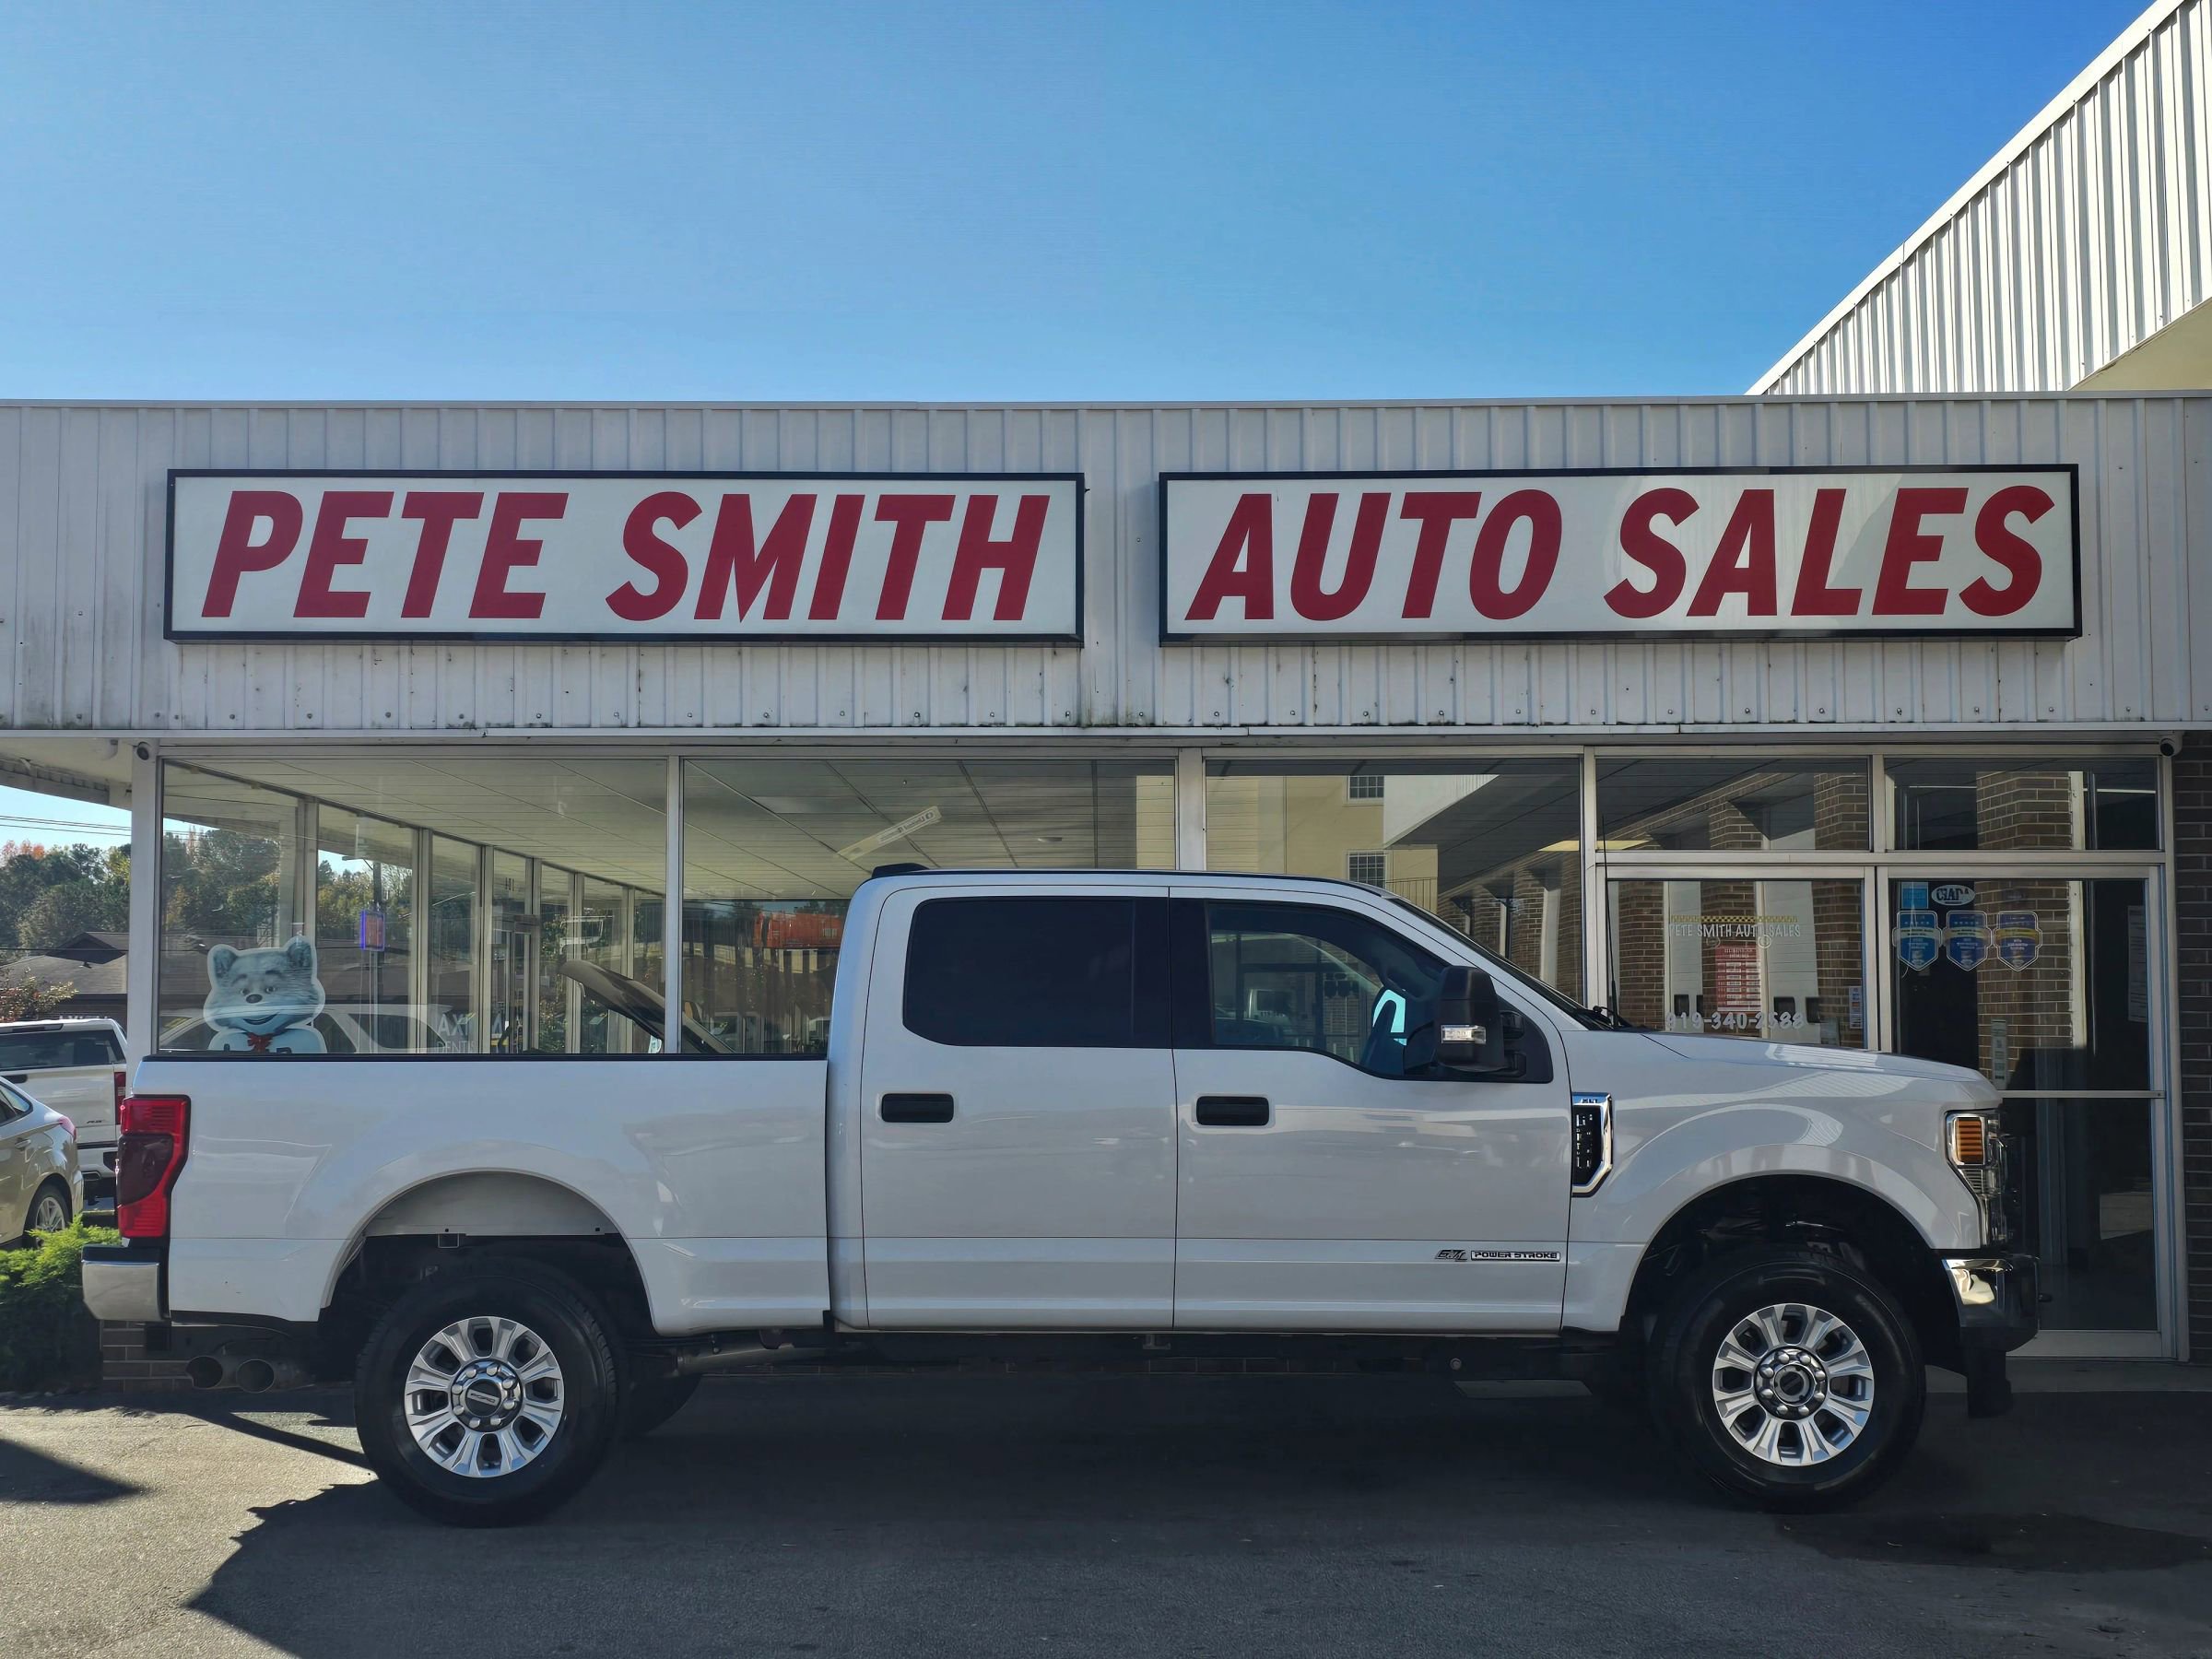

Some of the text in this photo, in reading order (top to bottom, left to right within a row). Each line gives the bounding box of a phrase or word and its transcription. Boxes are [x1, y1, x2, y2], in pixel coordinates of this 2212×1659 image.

[202, 490, 1051, 622] PETE SMITH
[1184, 485, 2055, 620] AUTO SALES
[1697, 924, 1732, 937] SMITH
[1769, 924, 1801, 937] SALES
